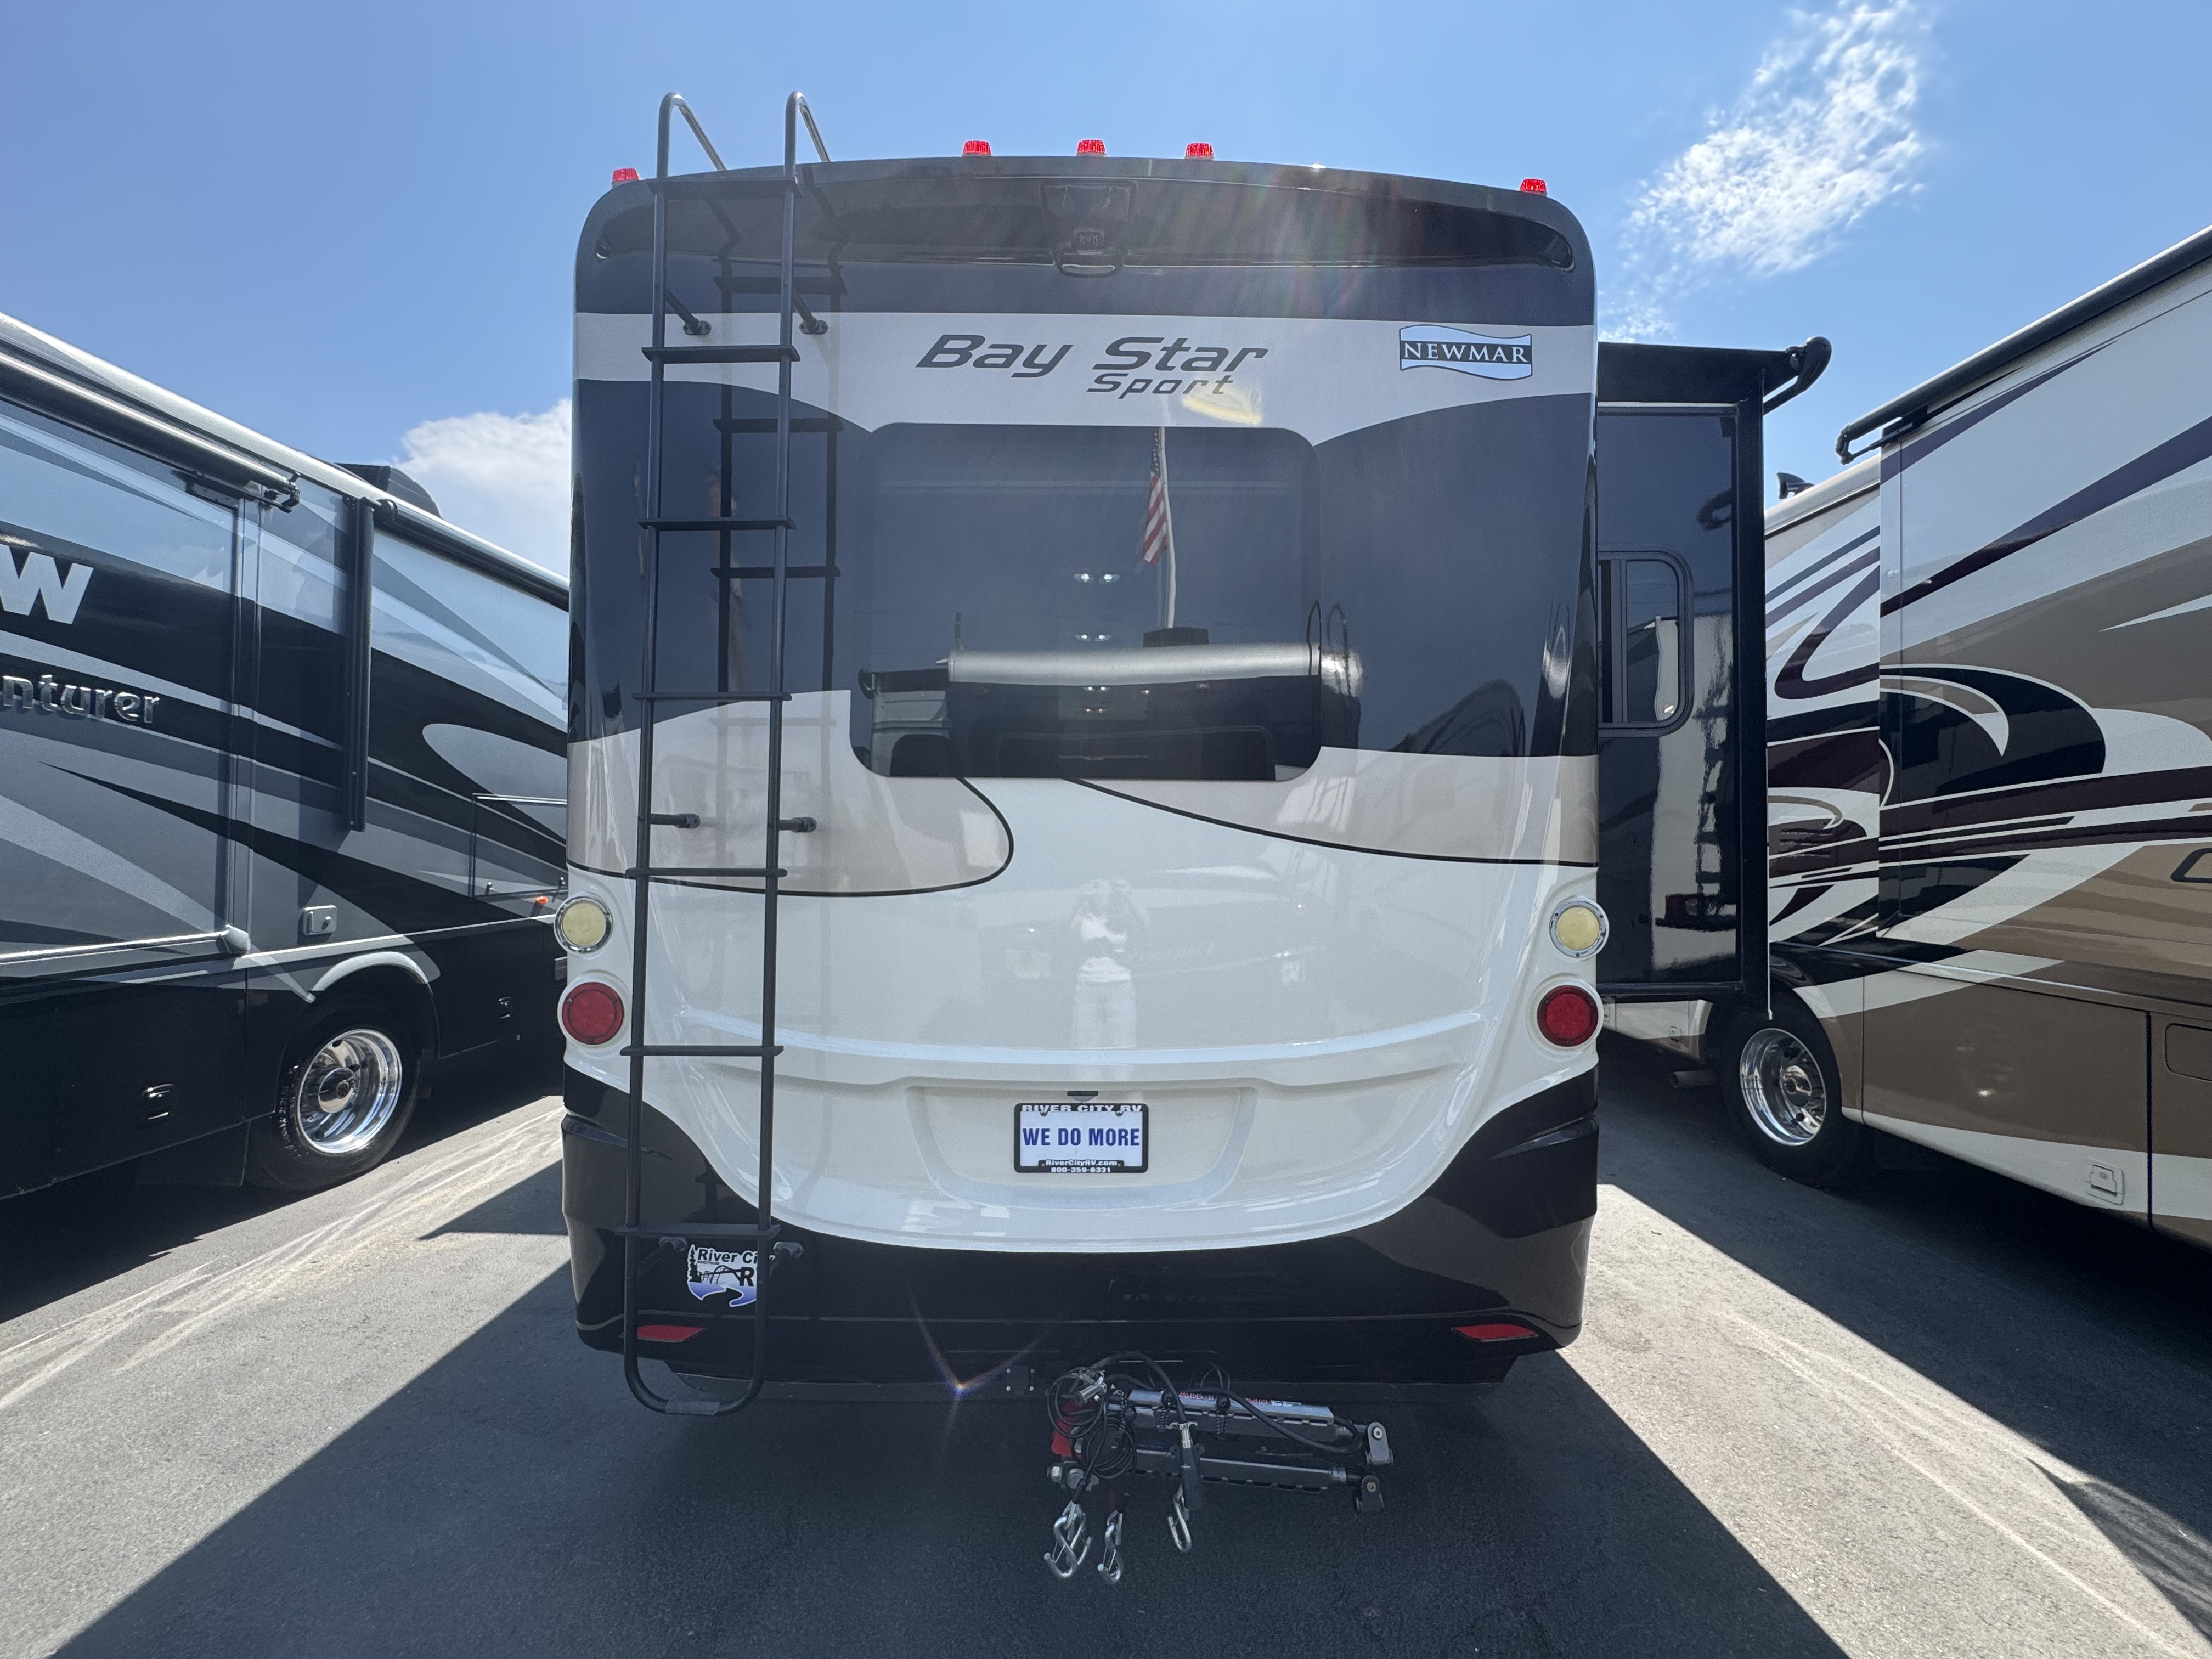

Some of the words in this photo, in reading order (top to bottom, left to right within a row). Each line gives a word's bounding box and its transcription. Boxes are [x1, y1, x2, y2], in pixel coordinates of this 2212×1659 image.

[915, 334, 1074, 378] Bay
[1091, 336, 1268, 373] Star
[1403, 341, 1529, 363] NEWMAR
[1086, 373, 1234, 400] Sport
[1023, 1128, 1051, 1146] WE
[1058, 1127, 1081, 1146] DO
[1088, 1128, 1140, 1147] MORE
[697, 1249, 738, 1262] River
[739, 1266, 756, 1287] R
